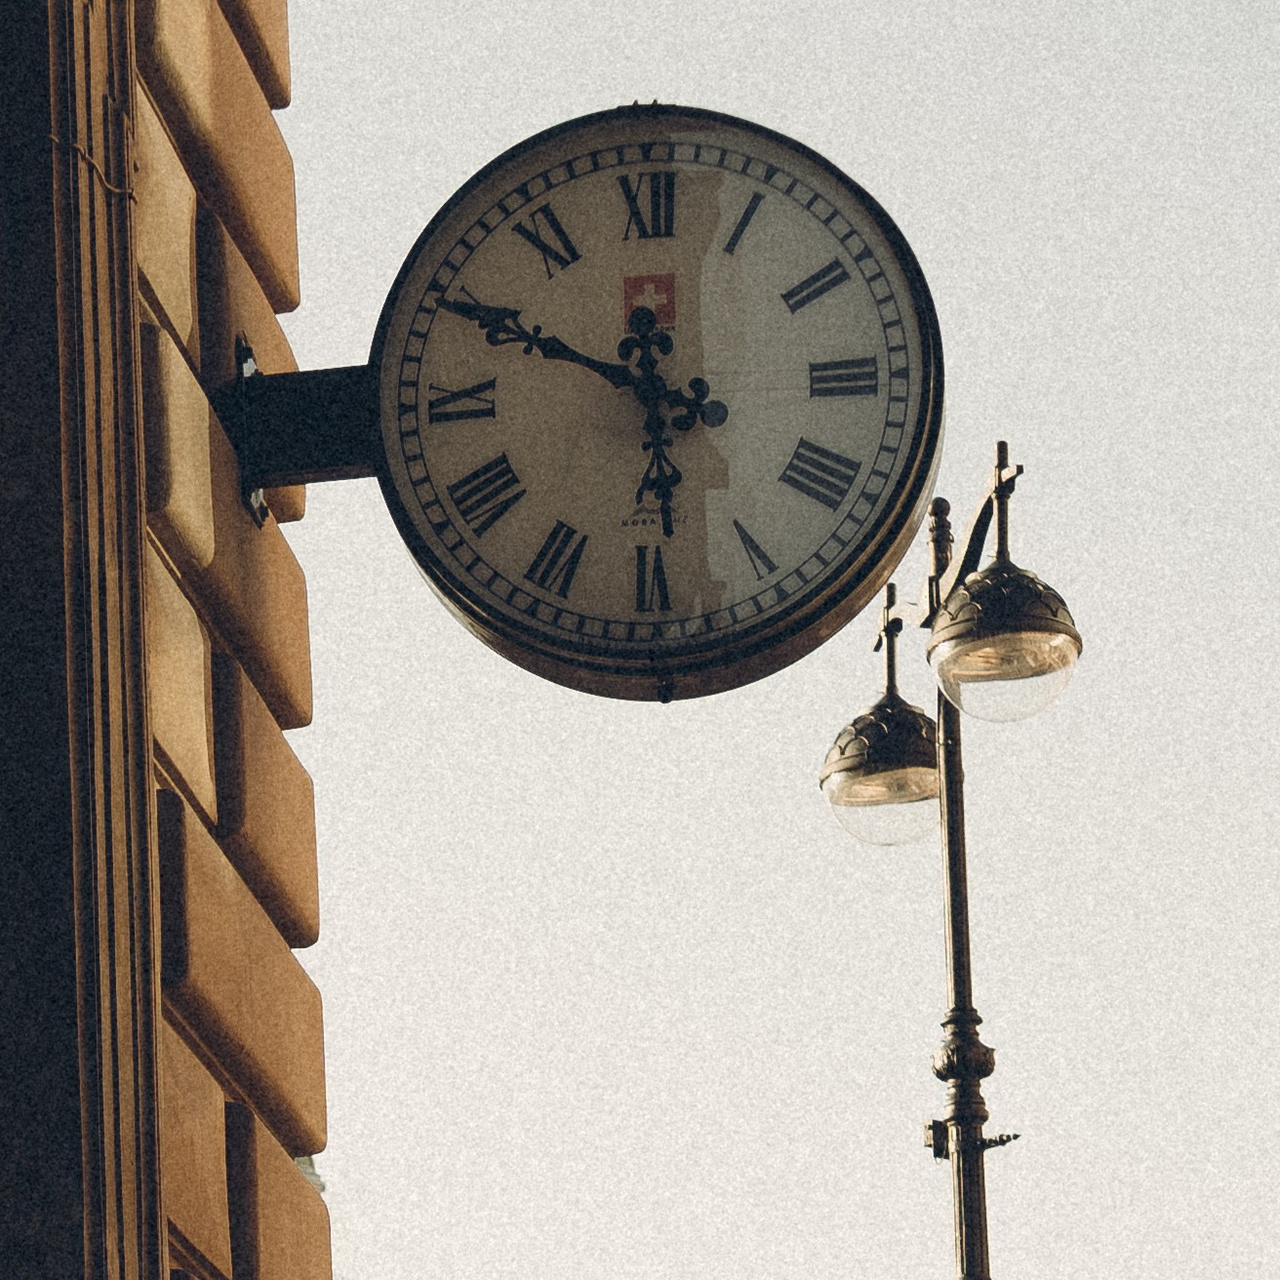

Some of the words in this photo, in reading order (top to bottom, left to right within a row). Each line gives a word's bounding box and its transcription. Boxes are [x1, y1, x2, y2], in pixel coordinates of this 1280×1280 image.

[617, 171, 676, 241] XII
[723, 192, 766, 256] I
[511, 202, 583, 280] XI
[780, 256, 851, 315] II
[428, 376, 497, 425] IX
[808, 354, 878, 399] III
[446, 452, 527, 538] VIII
[778, 436, 862, 513] IIII
[524, 519, 589, 599] VII
[634, 545, 672, 613] VI
[733, 519, 779, 581] V
